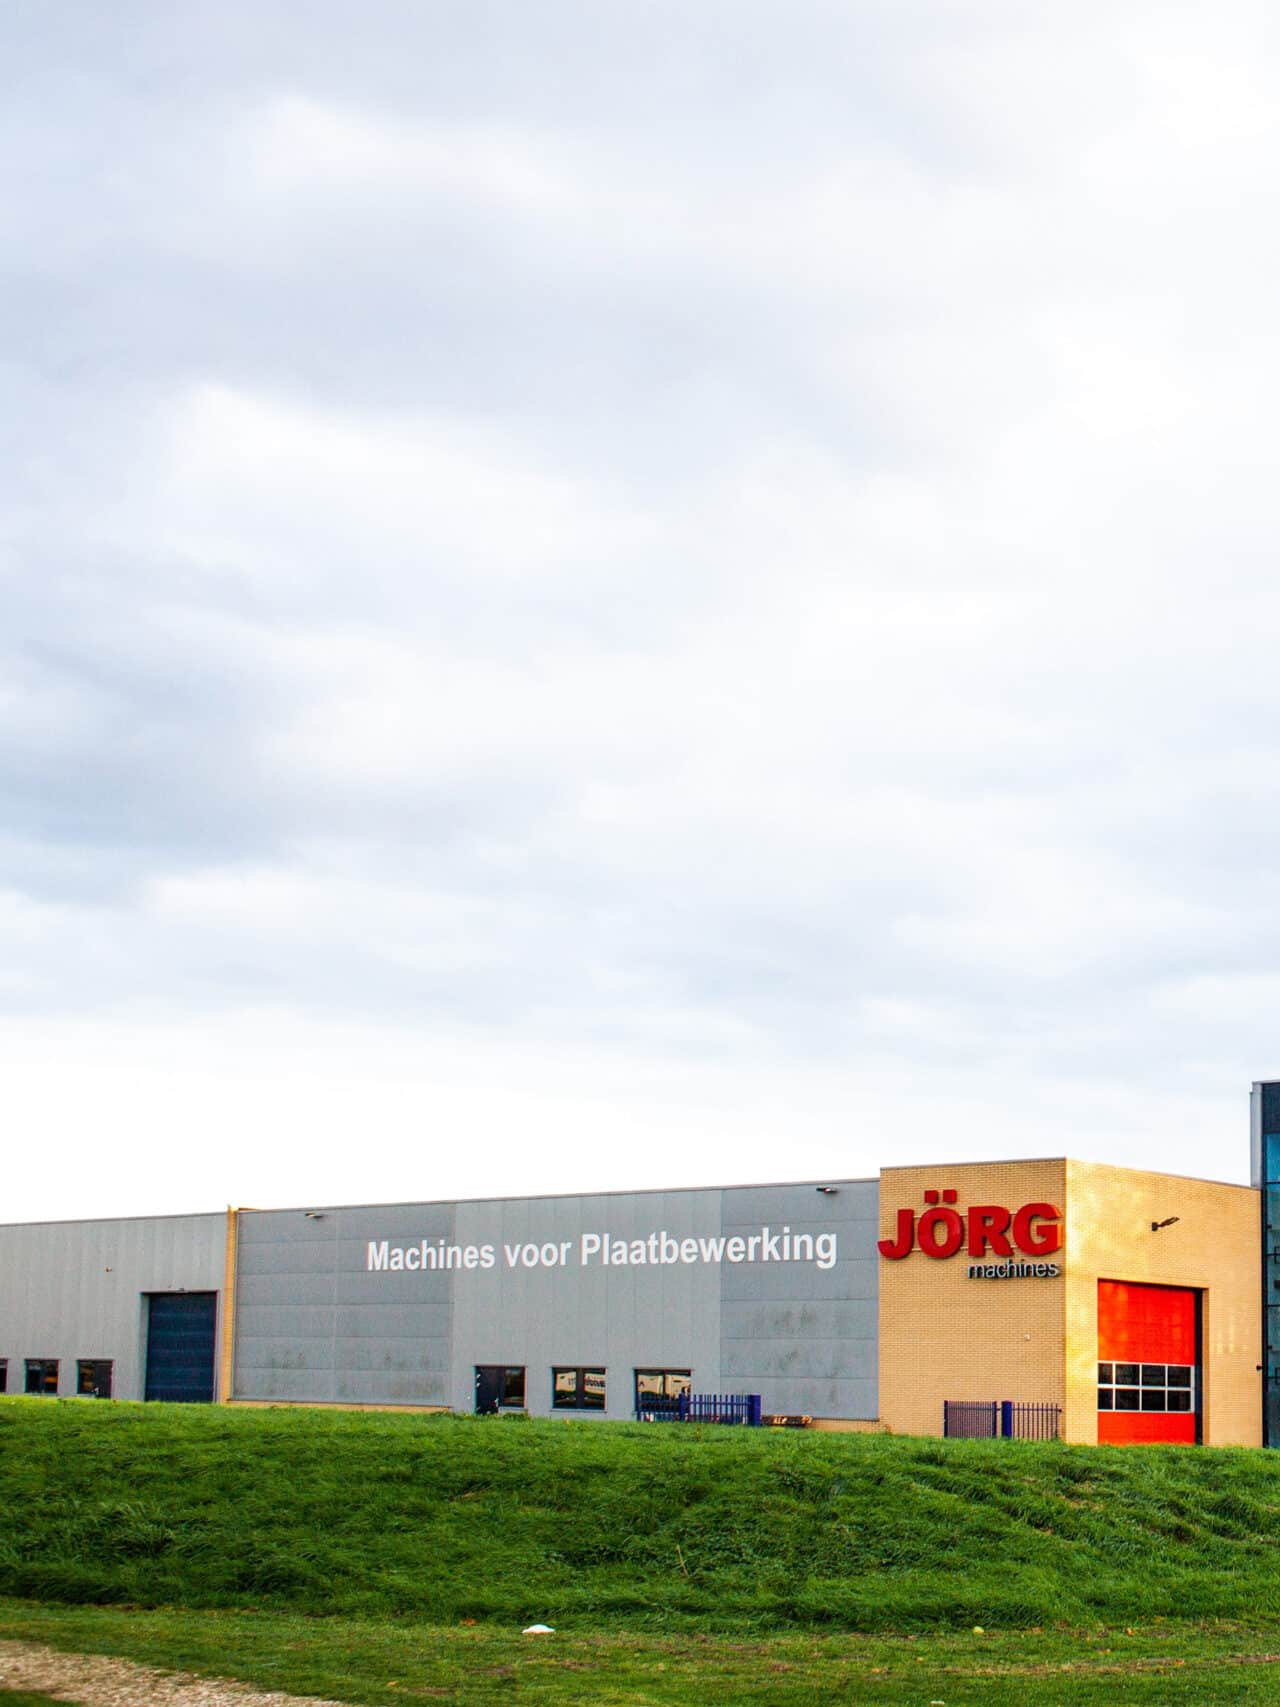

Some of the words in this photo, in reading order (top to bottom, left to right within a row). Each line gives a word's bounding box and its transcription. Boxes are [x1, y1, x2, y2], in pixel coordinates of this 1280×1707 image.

[877, 1189, 1064, 1259] JÖRG
[367, 1241, 496, 1271] Machines
[505, 1241, 572, 1268] voor
[581, 1227, 838, 1269] Plaatbewerking
[967, 1260, 1061, 1279] machines
